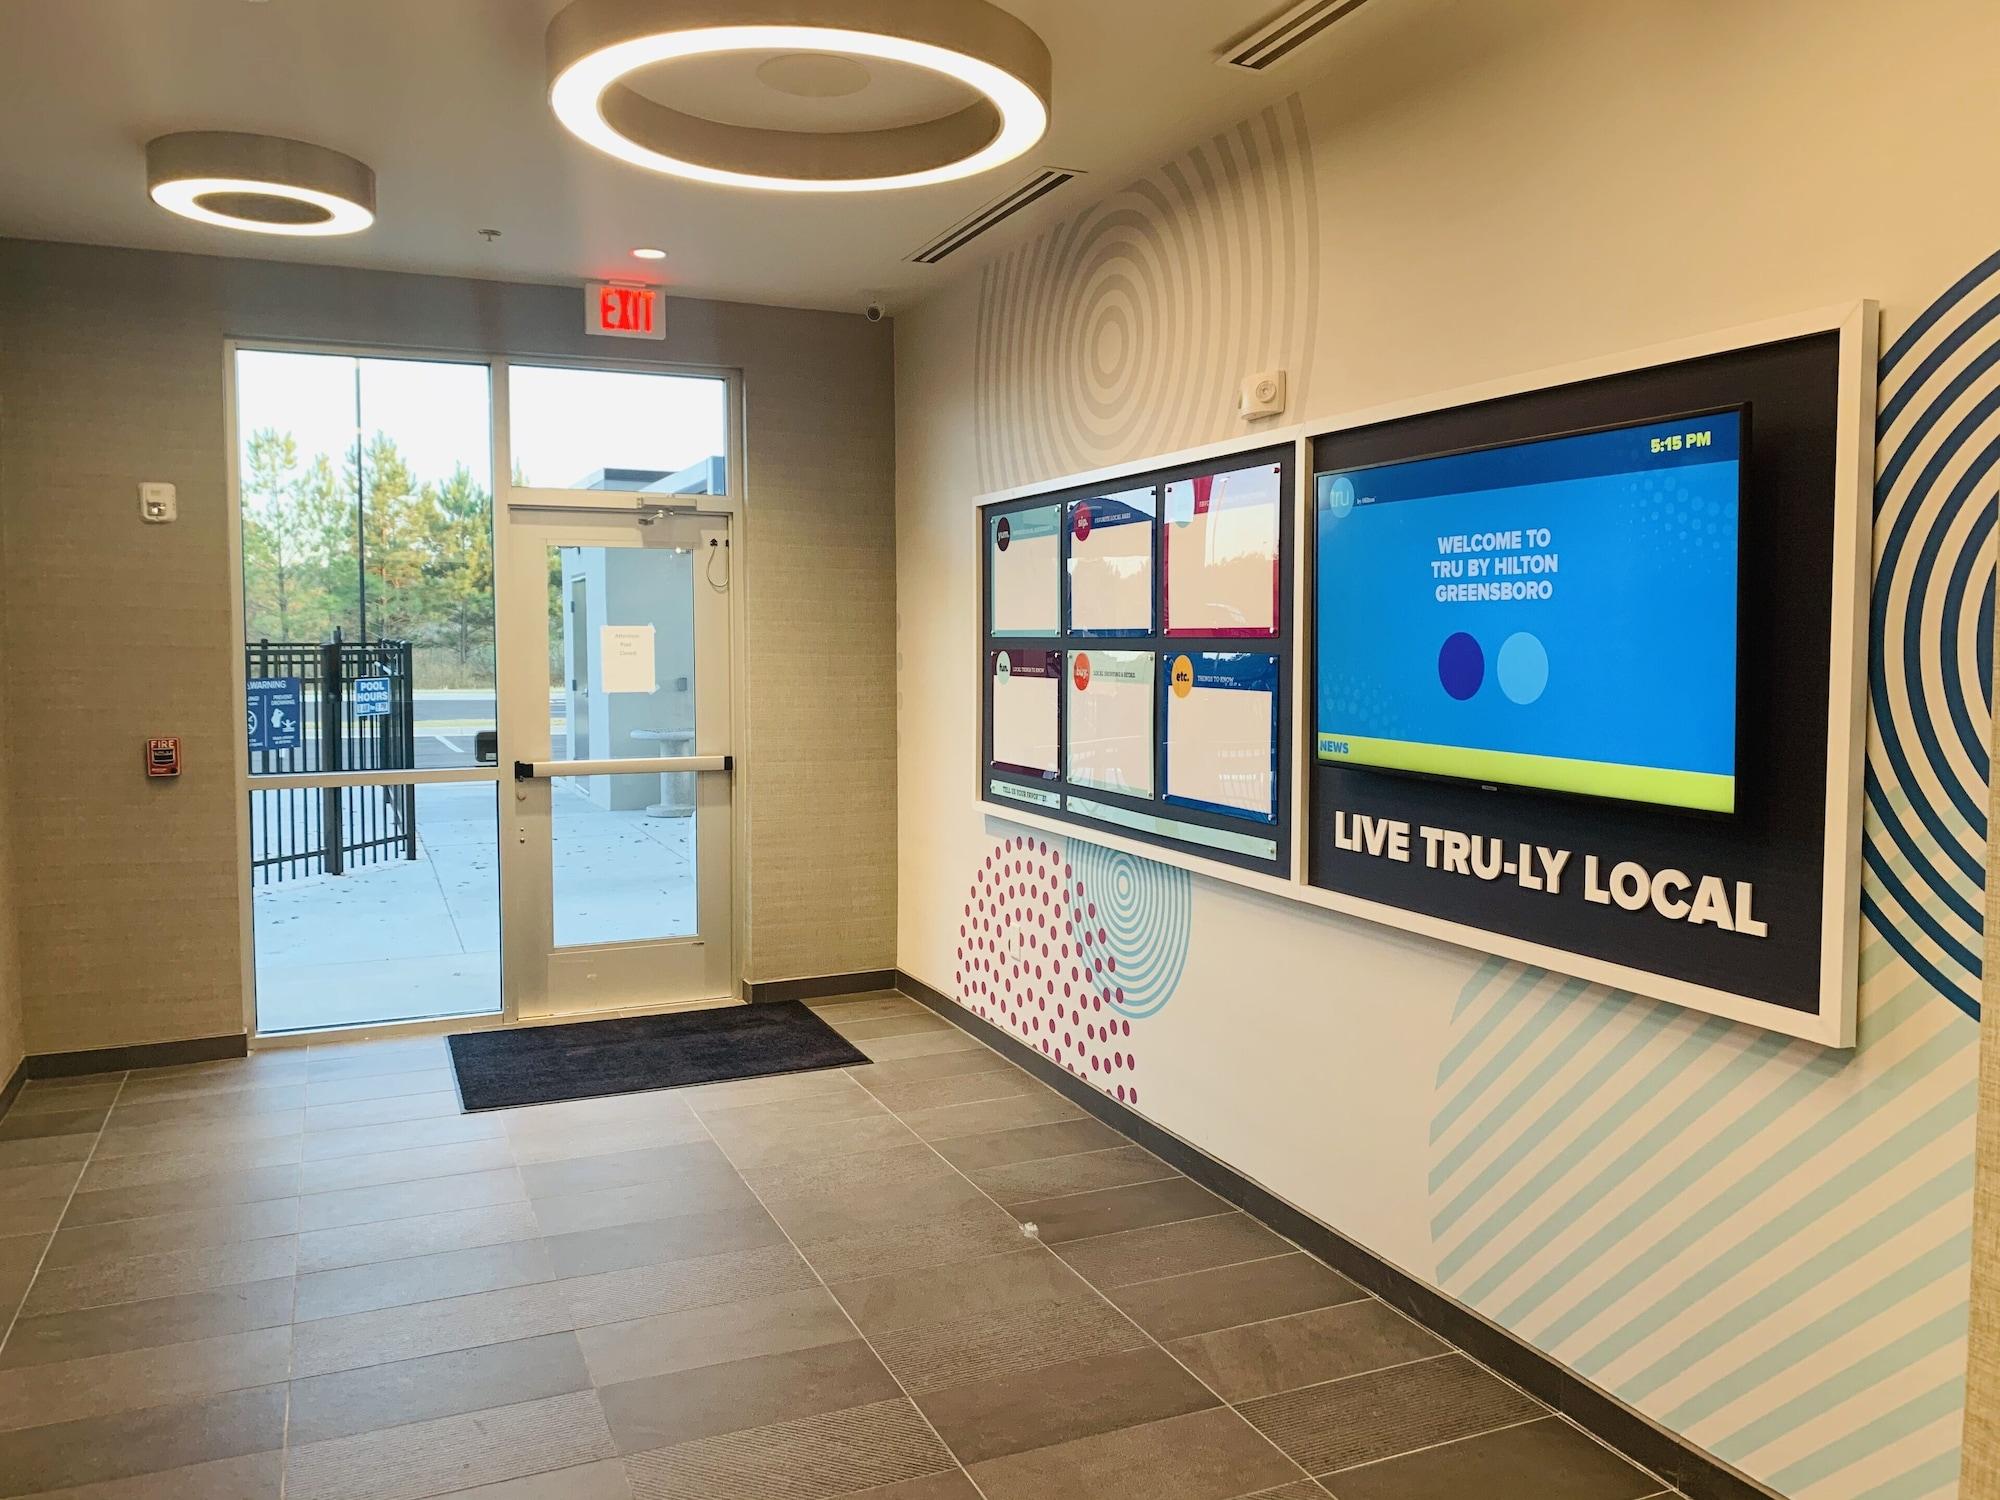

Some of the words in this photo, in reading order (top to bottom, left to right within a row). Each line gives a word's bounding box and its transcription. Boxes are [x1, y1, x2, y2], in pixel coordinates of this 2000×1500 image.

[600, 286, 656, 332] EXIT
[1650, 434, 1683, 453] 5:15
[1685, 430, 1712, 449] PM
[1331, 488, 1350, 507] tru
[1437, 530, 1522, 555] WELCOME
[1525, 527, 1552, 549] TO
[1430, 559, 1464, 579] TRU
[1467, 558, 1491, 577] BY
[1494, 553, 1559, 576] HILTON
[1435, 579, 1554, 603] GREENSBORO
[1176, 671, 1190, 682] etc.
[1213, 675, 1220, 683] TO
[249, 680, 287, 690] WARNING
[360, 681, 385, 691] POOL
[357, 691, 388, 702] HOURS
[150, 740, 176, 749] FIRE
[1319, 740, 1349, 754] NEWS
[1334, 809, 1411, 863] LIVE
[1418, 824, 1572, 895] TRU-LY
[1583, 853, 1768, 938] LOCAL
